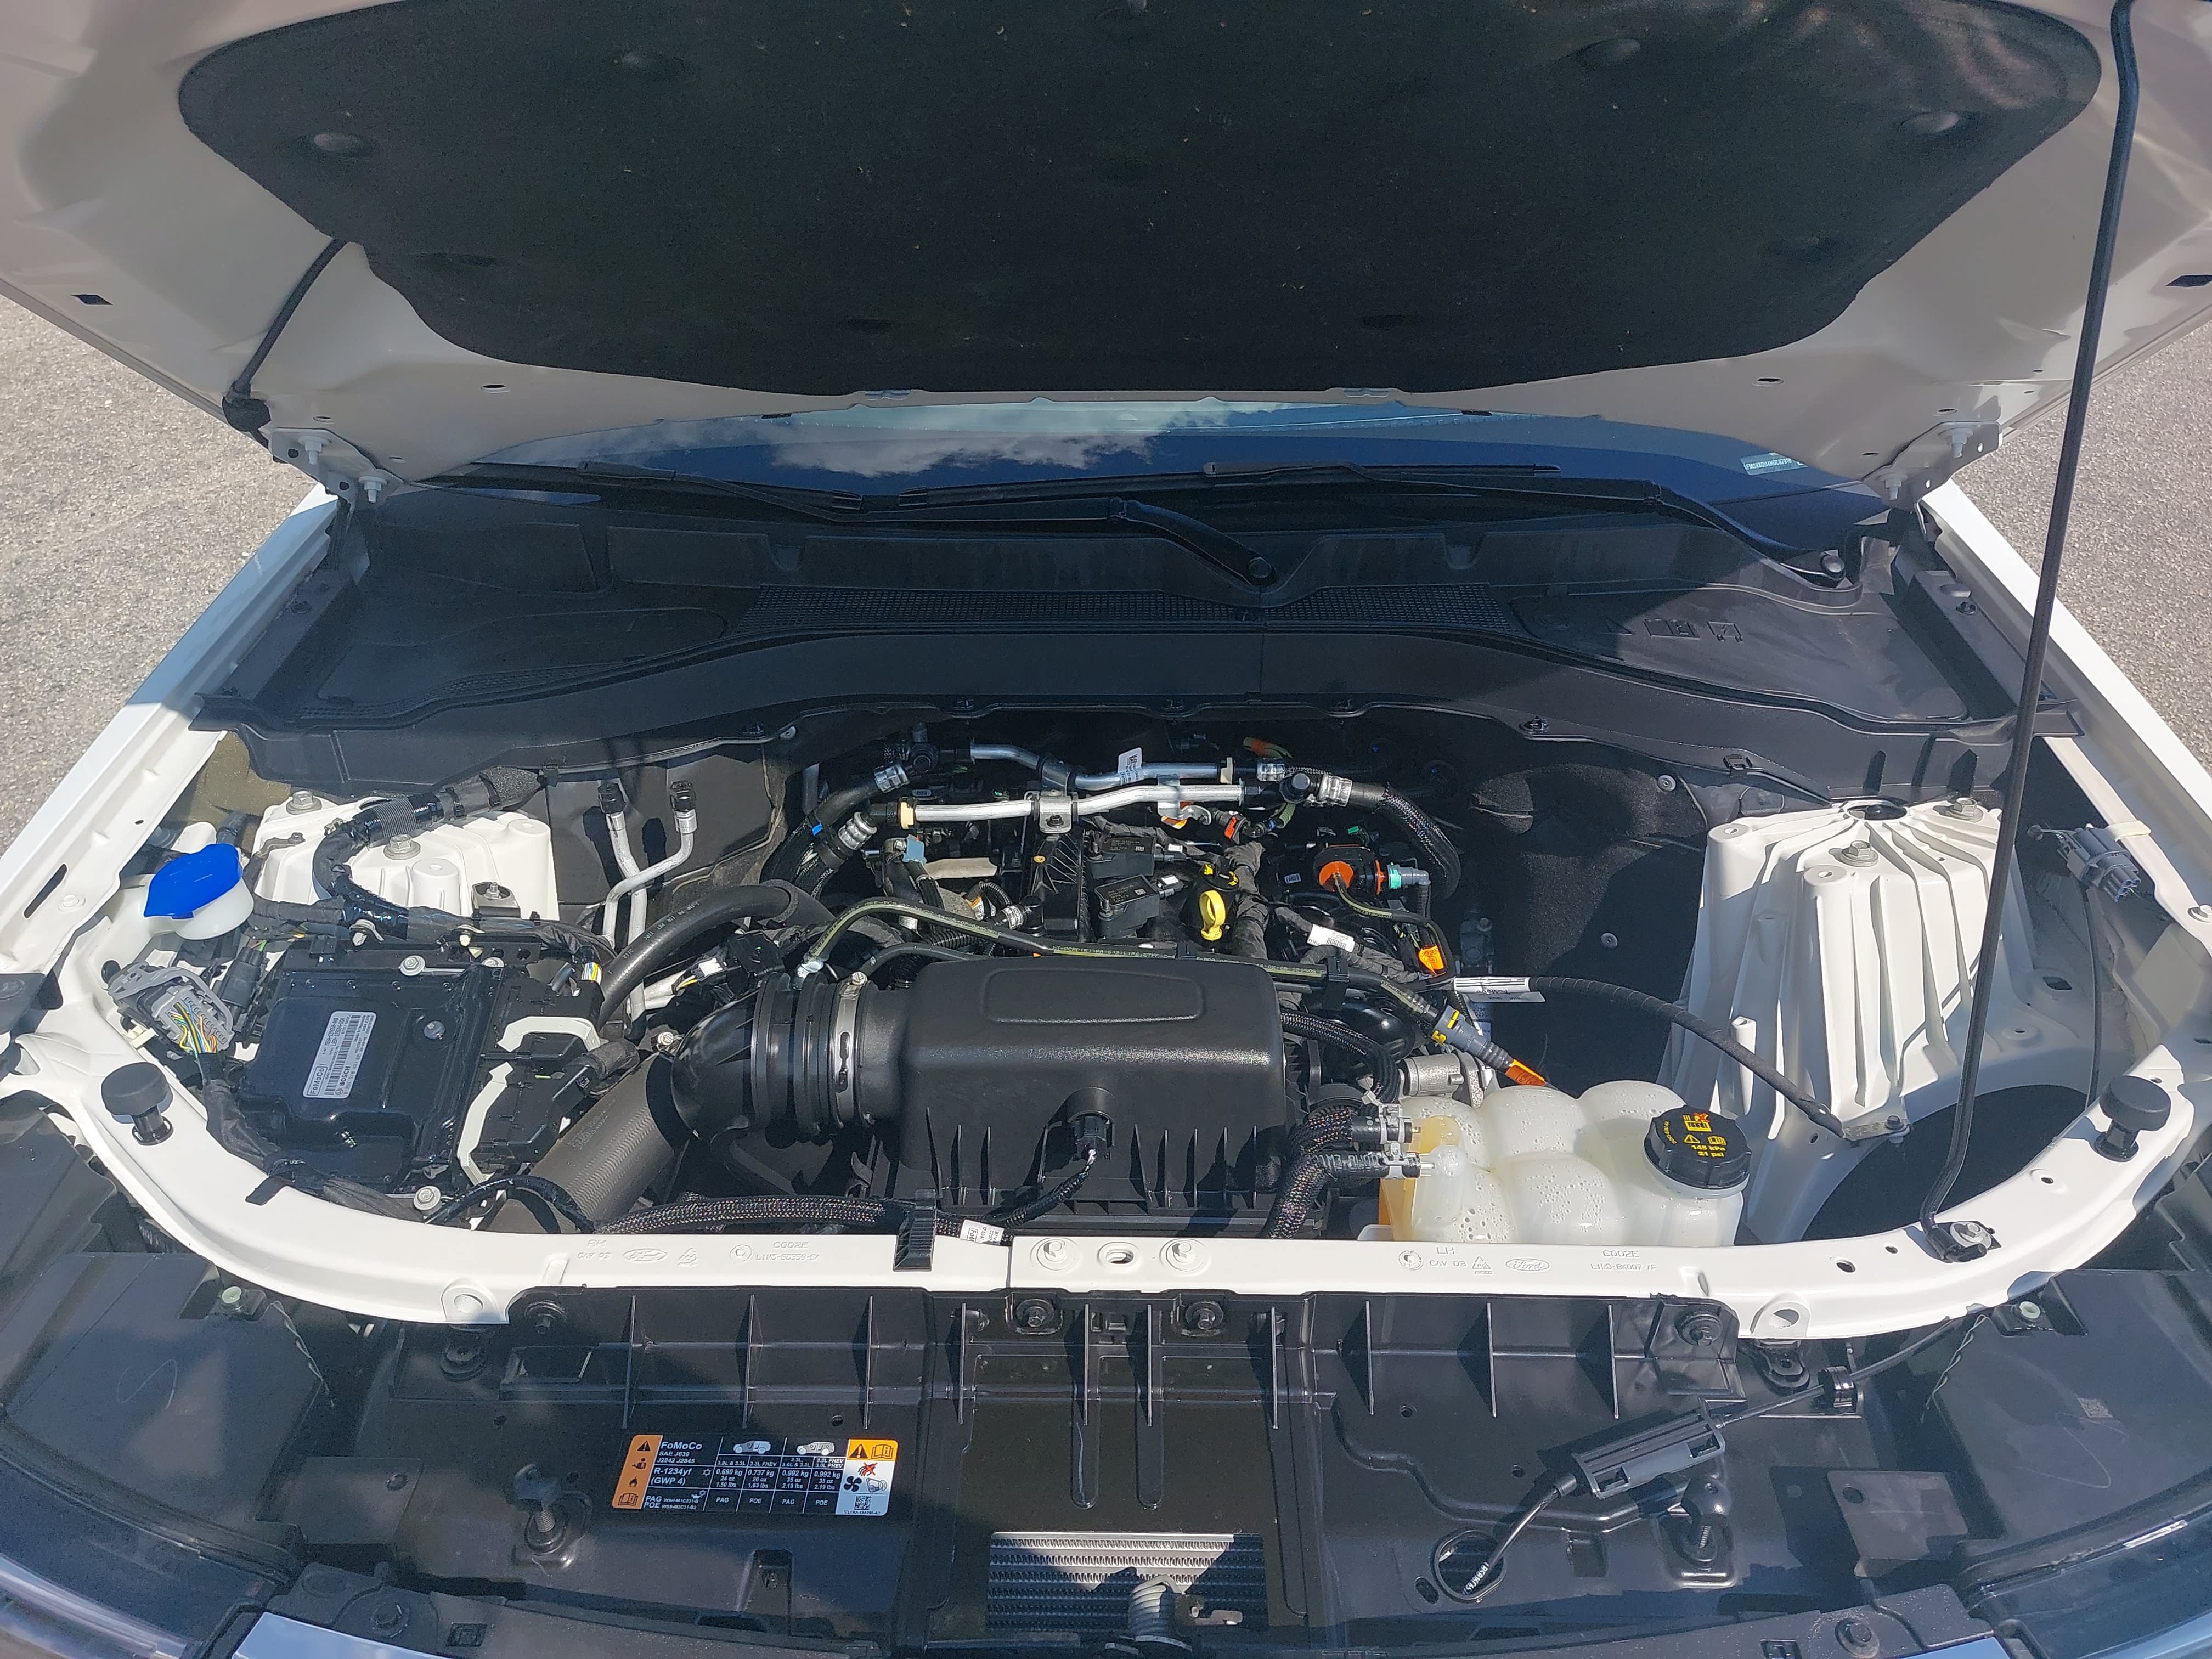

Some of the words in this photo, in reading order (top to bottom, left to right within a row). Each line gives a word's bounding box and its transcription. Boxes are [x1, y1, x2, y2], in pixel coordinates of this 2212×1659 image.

[339, 1066, 351, 1086] BOSCH
[310, 1068, 325, 1094] FoMoCo
[661, 1442, 702, 1450] FoMoCo
[653, 1468, 692, 1477] R-1234yf
[651, 1477, 676, 1485] (GWP
[677, 1477, 686, 1486] 4)
